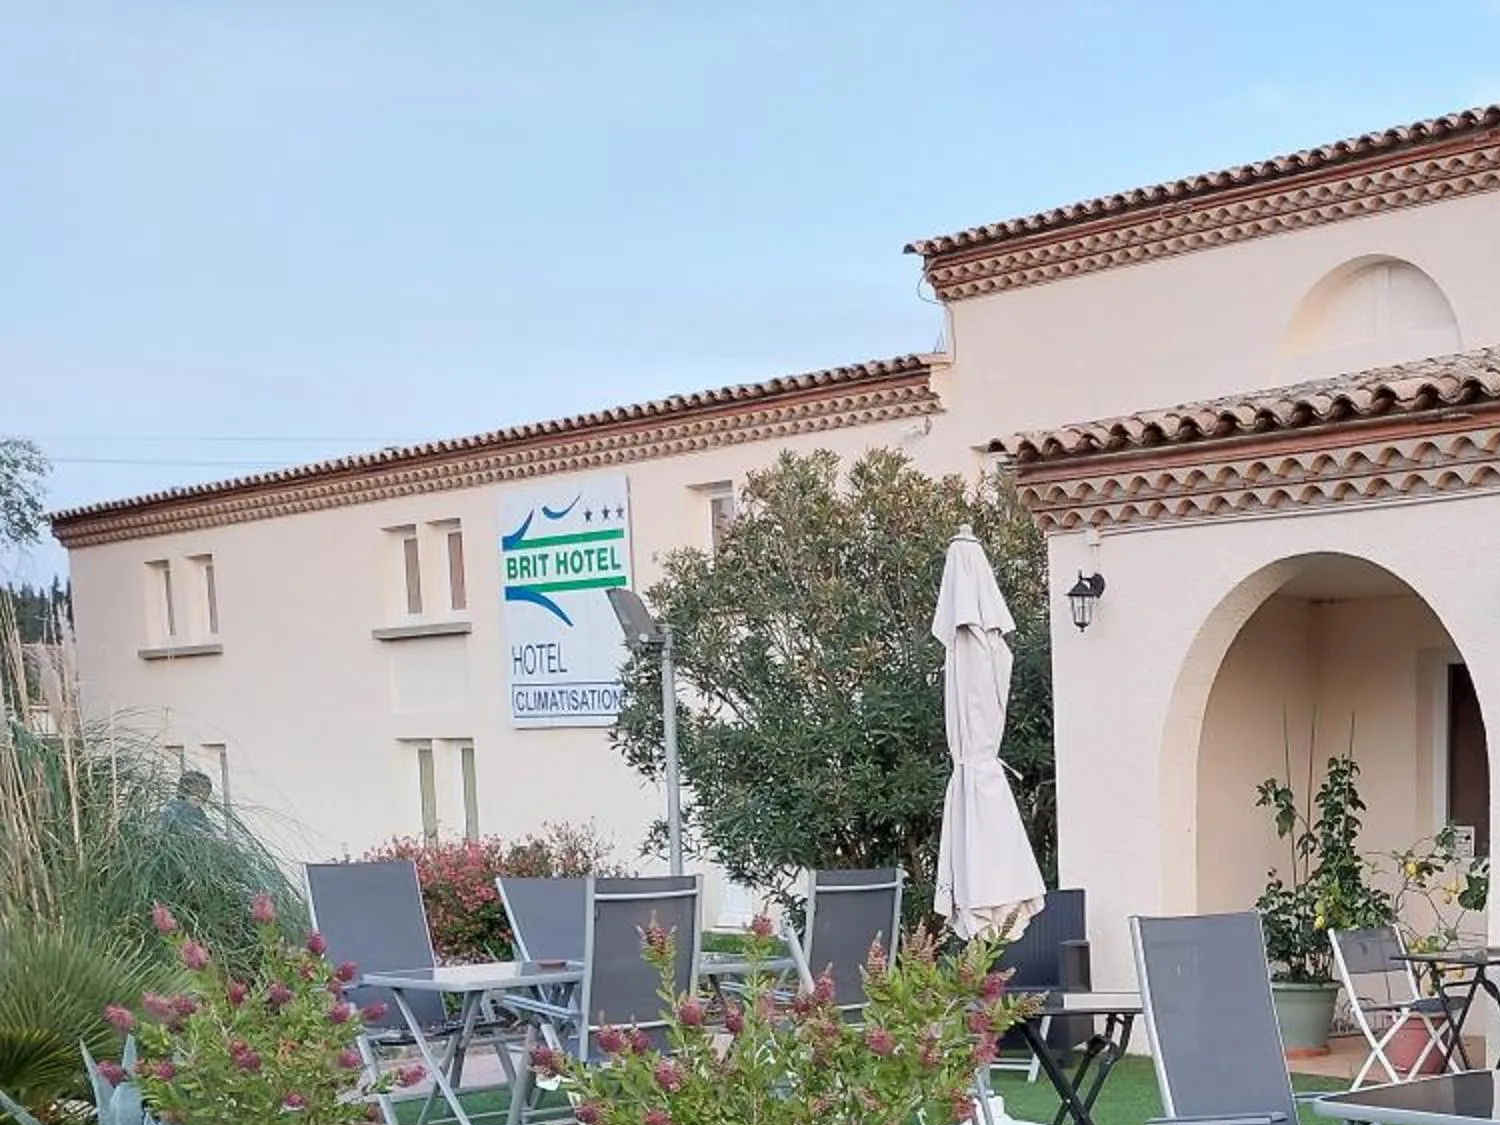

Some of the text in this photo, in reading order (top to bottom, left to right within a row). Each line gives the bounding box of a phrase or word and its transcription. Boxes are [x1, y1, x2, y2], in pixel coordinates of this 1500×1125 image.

[507, 546, 621, 580] BRIT HOTEL
[512, 643, 567, 675] HOTEL
